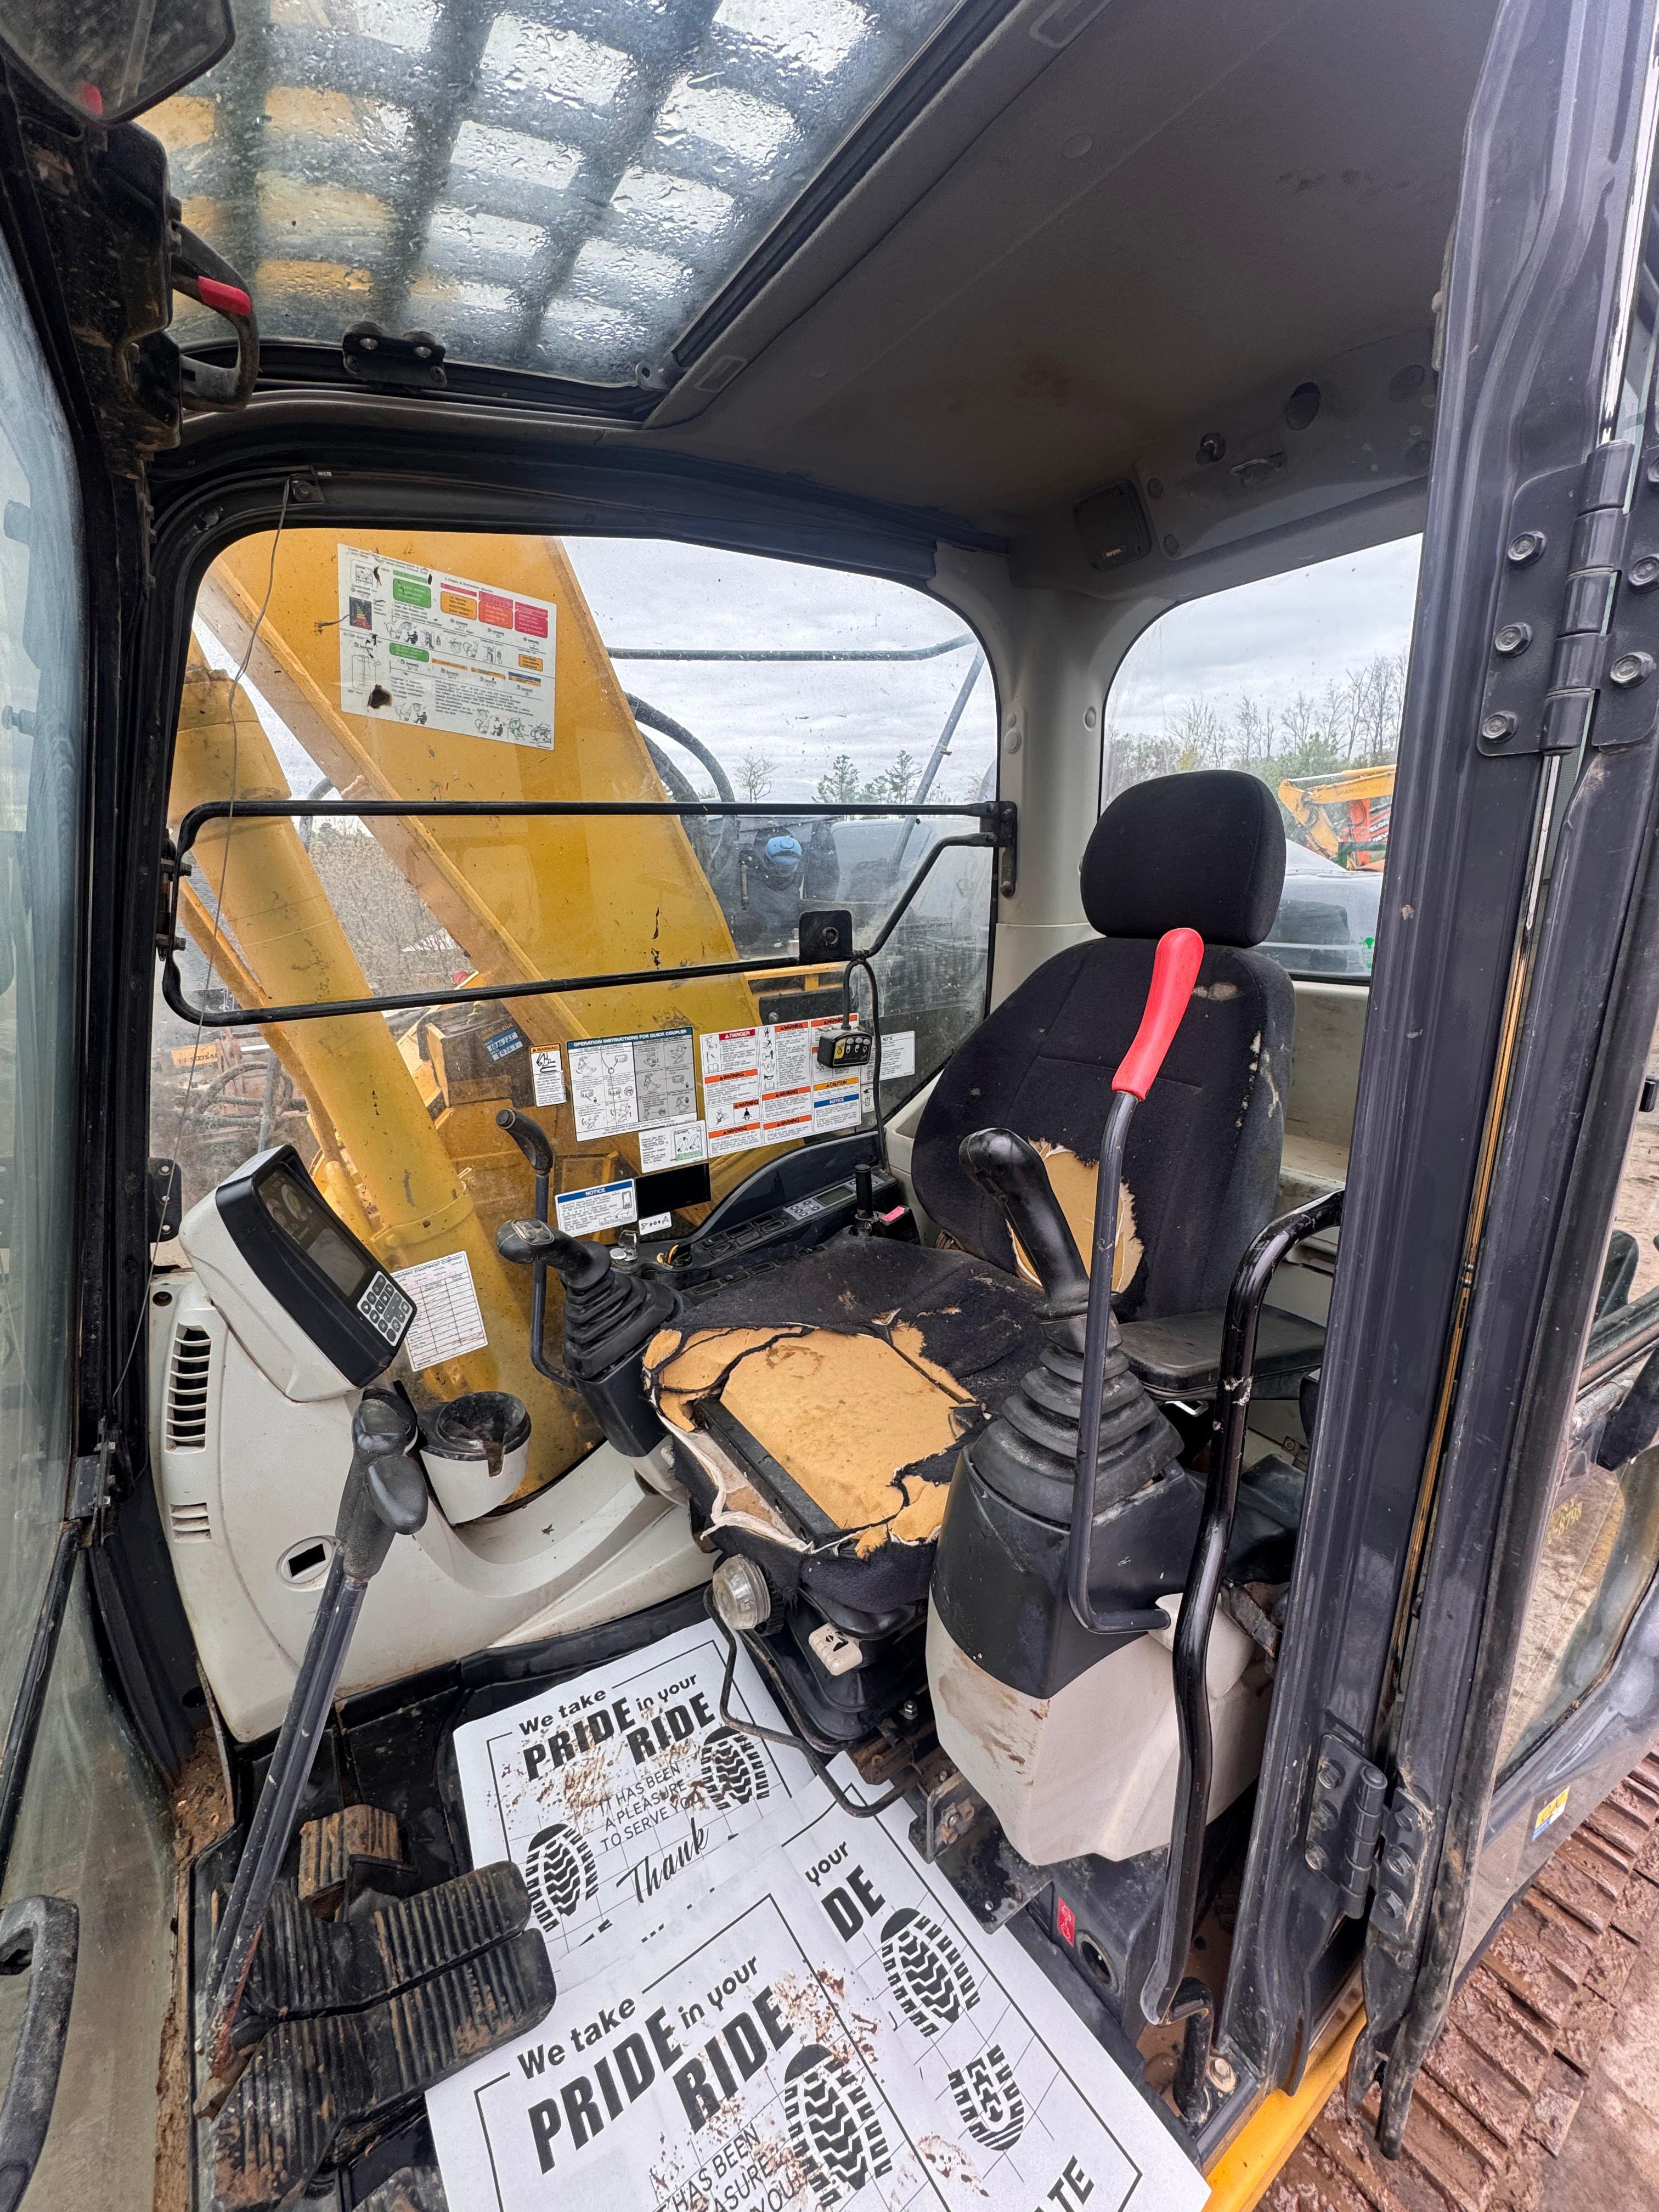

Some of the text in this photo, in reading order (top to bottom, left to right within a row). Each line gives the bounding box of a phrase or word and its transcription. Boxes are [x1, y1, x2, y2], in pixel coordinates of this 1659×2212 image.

[573, 1039, 602, 1047] OPERATION
[603, 1035, 639, 1044] INSTRUCTIONS
[726, 1125, 747, 1134] WARNING
[585, 1187, 606, 1196] NOTICE
[414, 1262, 441, 1272] EQUIPMENT
[519, 1690, 606, 1736] We take
[523, 1674, 697, 1782] PRIDE in your
[627, 1691, 716, 1766] RIDE
[606, 1779, 687, 1832] A PLEASURE
[616, 1782, 645, 1806] HAS
[646, 1762, 681, 1789] BEEN
[600, 1832, 622, 1852] TO
[624, 1806, 670, 1840] SERVE
[616, 1817, 710, 1904] Thank
[804, 1841, 847, 1886] your
[821, 1864, 886, 1943] DE
[517, 1999, 636, 2079] We take
[528, 1956, 758, 2175] PRIDE in your
[672, 1985, 794, 2135] RIDE
[672, 2122, 761, 2212] HAS BEEN
[1034, 2154, 1095, 2212] TE
